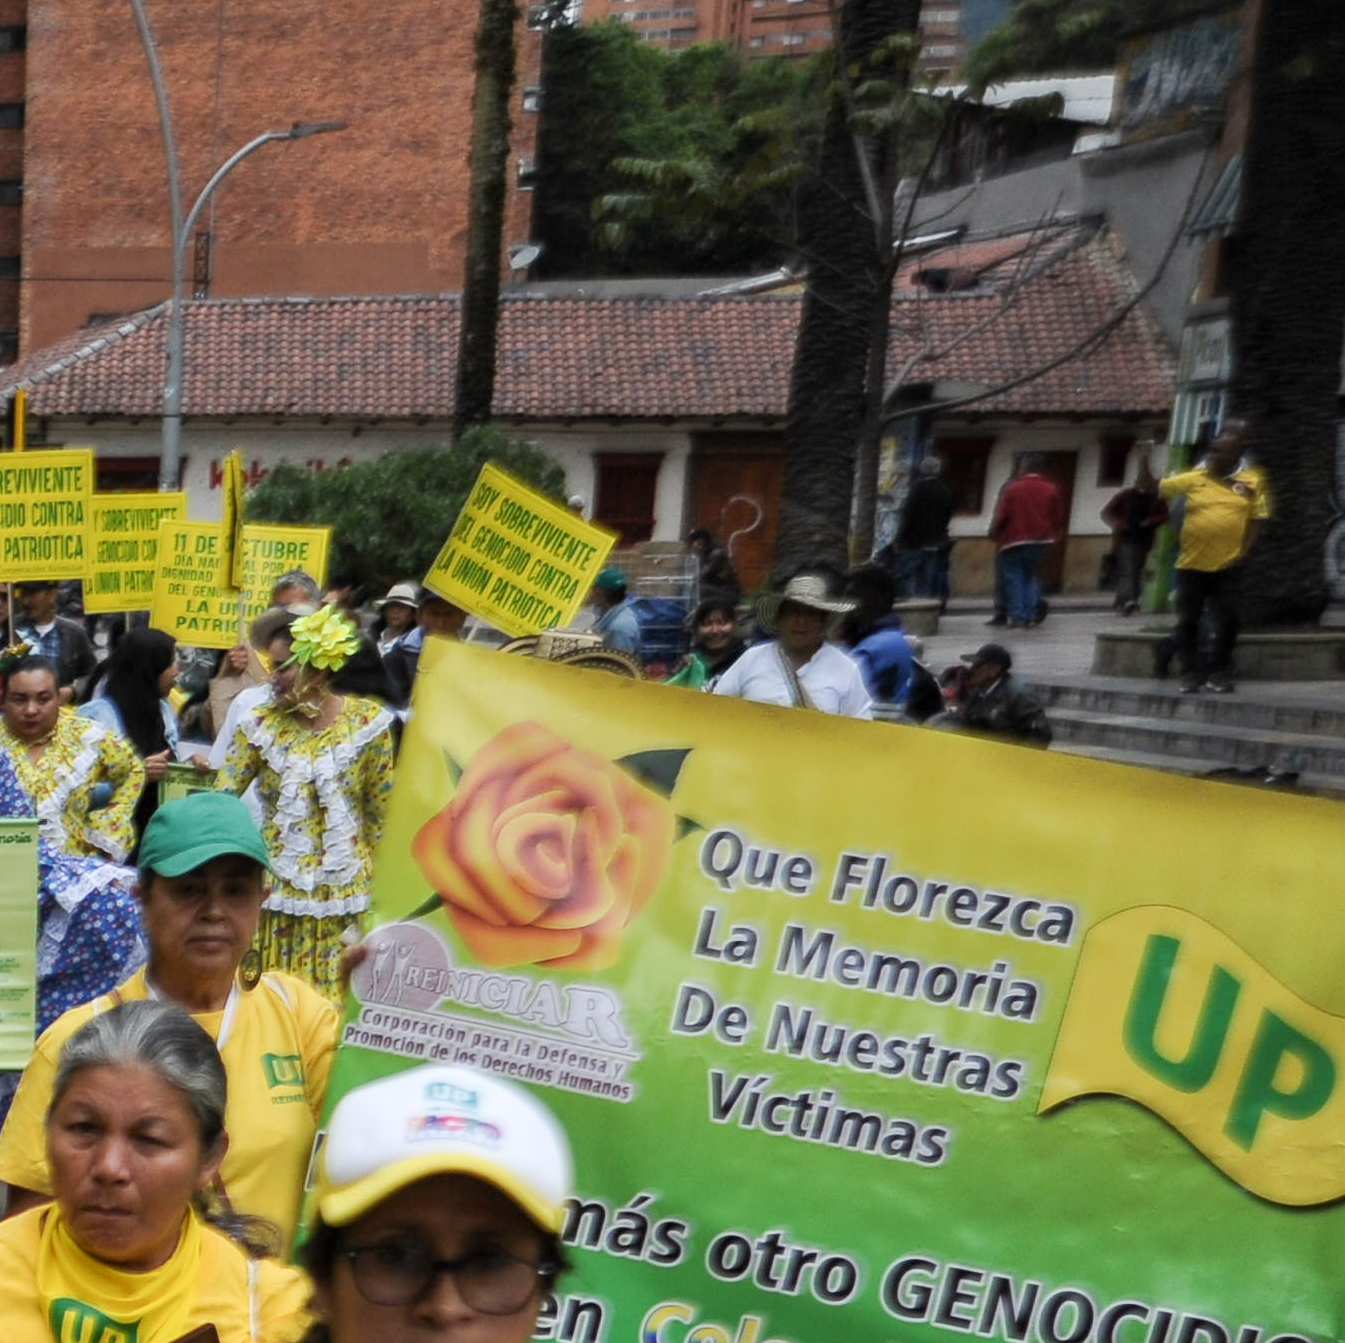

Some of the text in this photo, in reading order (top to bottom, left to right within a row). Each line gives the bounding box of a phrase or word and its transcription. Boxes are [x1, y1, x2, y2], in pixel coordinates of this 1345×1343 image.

[5, 531, 83, 563] PATRIÓTICA
[32, 501, 84, 527] CONTRA
[174, 534, 187, 552] 11
[196, 535, 219, 555] DE
[472, 483, 597, 572] SOY SOBREVIVIENTE
[168, 583, 187, 596] DEL
[437, 549, 456, 574] LA
[451, 552, 493, 596] UNIÓN
[490, 577, 563, 629] PATRIÓTICA
[453, 513, 580, 605] DEL GENOCIDIO CONTRA
[186, 600, 209, 614] LA
[697, 826, 1078, 945] Que Florezca
[691, 906, 1040, 1022] La Memoria
[362, 1008, 624, 1078] Corporación para la Defensa y
[404, 965, 628, 1049] REINICIAR
[671, 983, 1025, 1100] De Nuestras
[1123, 933, 1337, 1151] UP
[345, 1026, 631, 1100] Promoción de los Derechos Humanos
[707, 1068, 950, 1166] Víctimas
[559, 1193, 690, 1267] más
[706, 1229, 859, 1307] otro
